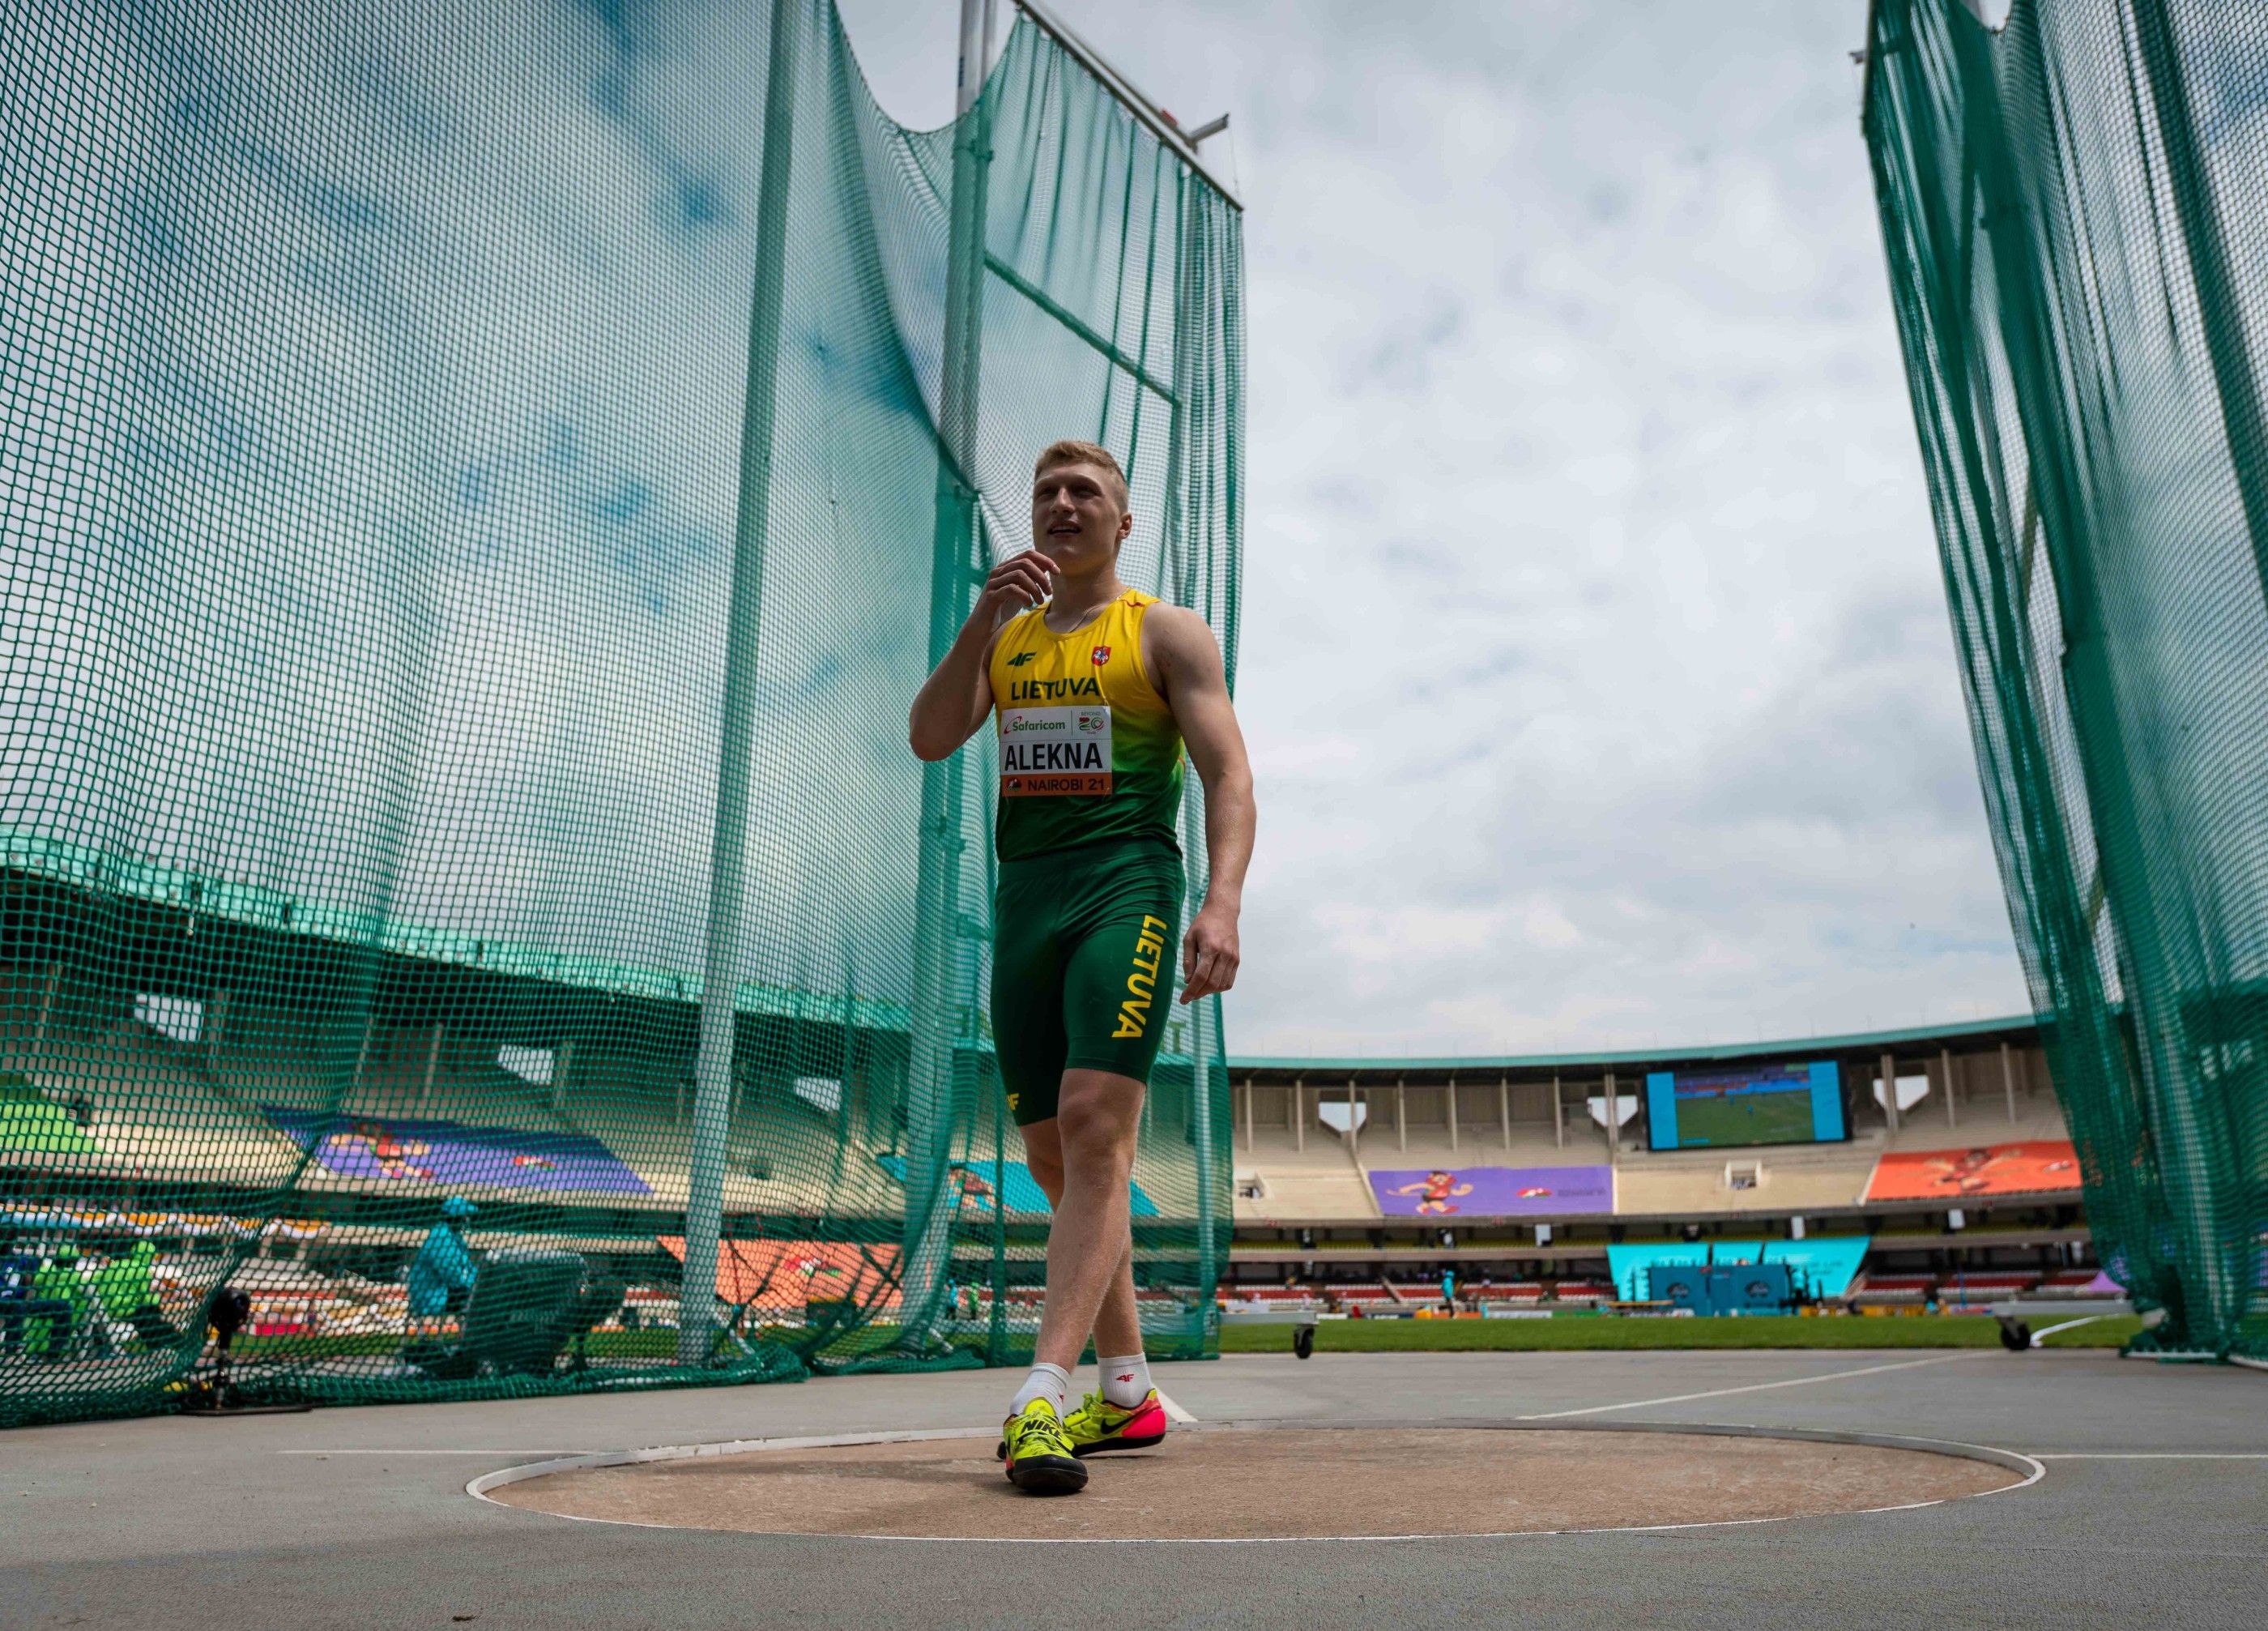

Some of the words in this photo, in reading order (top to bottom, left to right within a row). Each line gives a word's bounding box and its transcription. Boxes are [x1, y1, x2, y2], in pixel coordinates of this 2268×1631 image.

[1011, 677, 1101, 701] LIETUVA
[1013, 719, 1066, 732] Safaricom
[1004, 742, 1103, 771] ALEKNA
[1027, 779, 1083, 792] NAIROBI
[1088, 778, 1105, 791] 21
[1111, 914, 1167, 1038] LIETUVA
